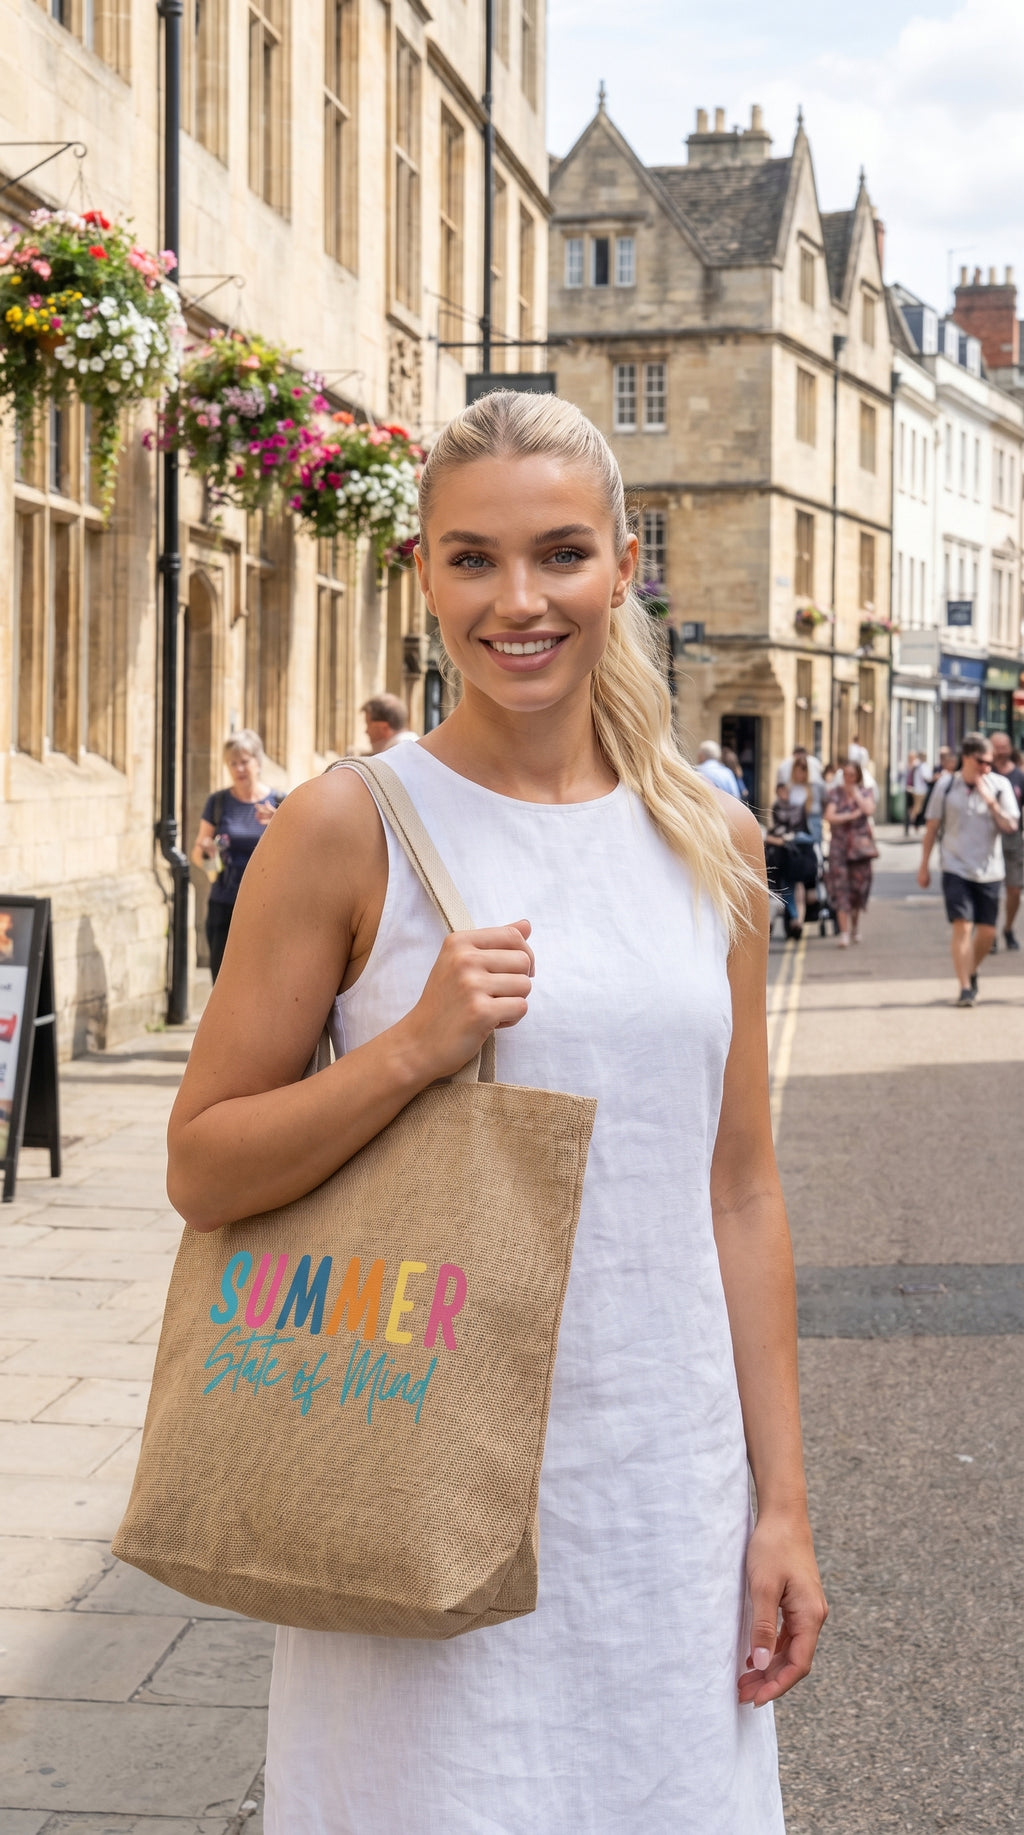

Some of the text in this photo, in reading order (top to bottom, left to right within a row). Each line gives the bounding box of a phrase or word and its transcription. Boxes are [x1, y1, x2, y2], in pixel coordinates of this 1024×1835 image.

[209, 1250, 468, 1351] SUMMER
[203, 1325, 438, 1425] State of Mind
